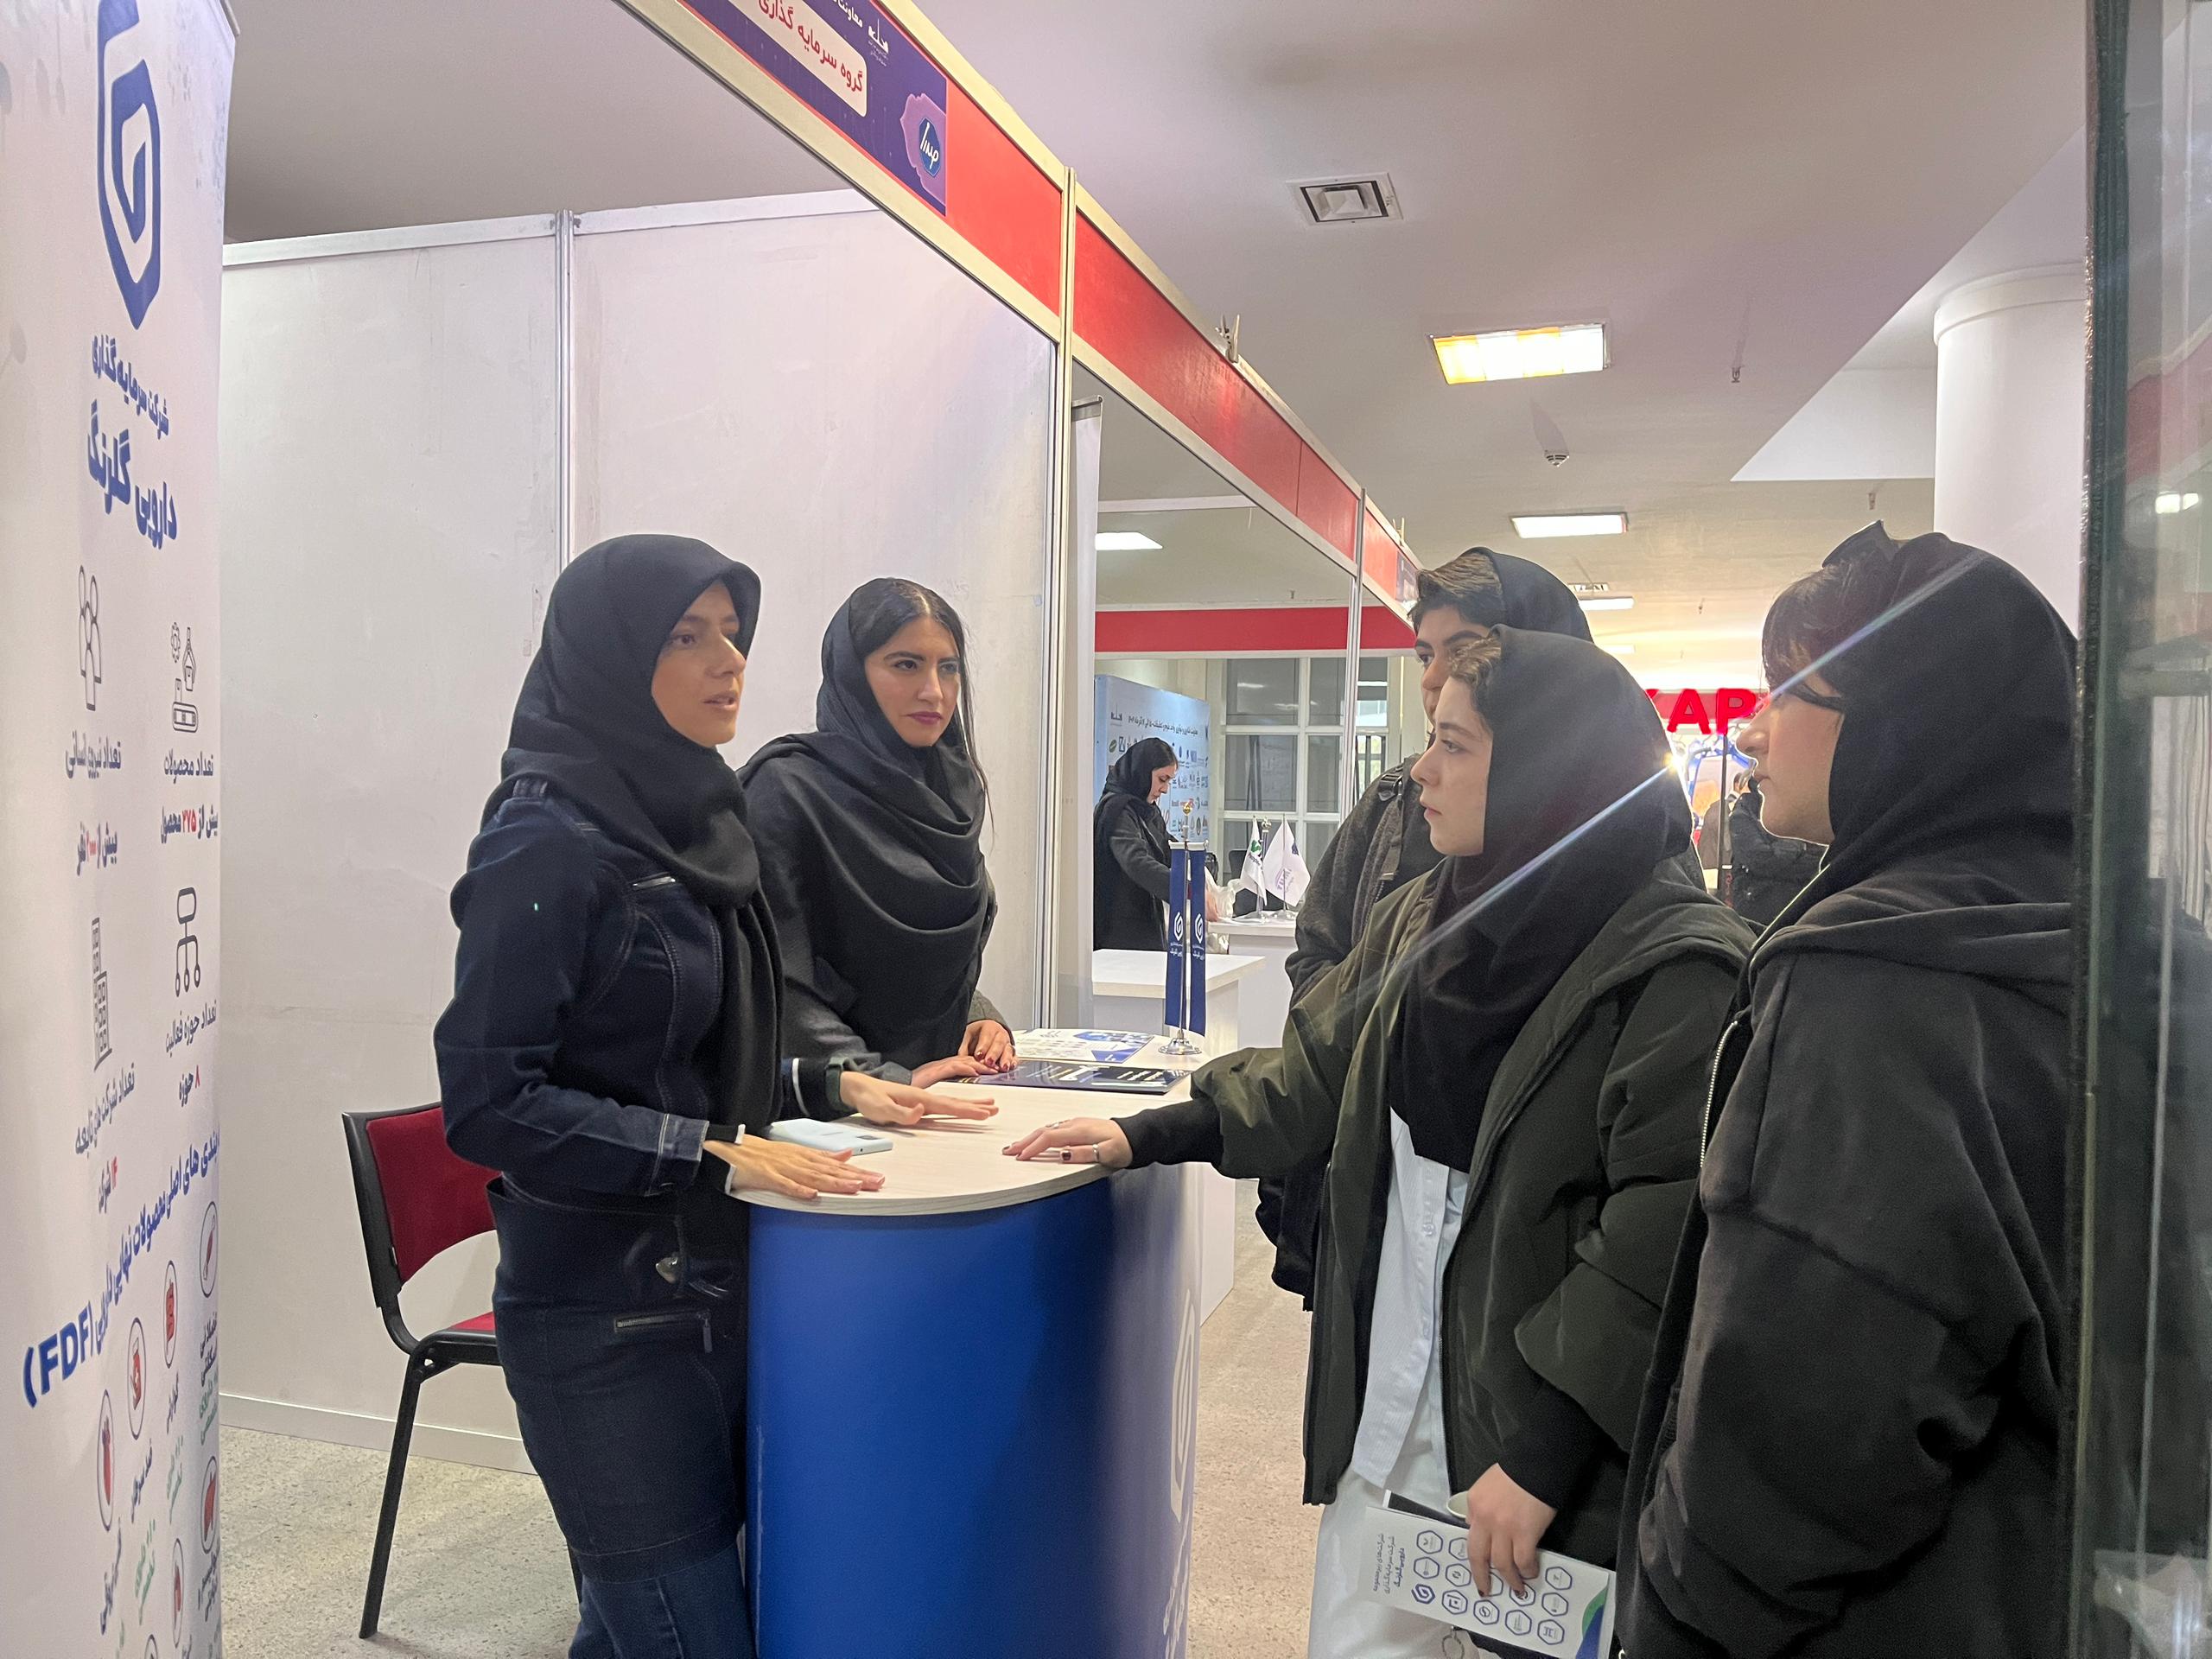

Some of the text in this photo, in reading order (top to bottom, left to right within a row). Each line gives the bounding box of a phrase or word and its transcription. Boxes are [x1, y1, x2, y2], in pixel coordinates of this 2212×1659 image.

[798, 25, 837, 69] سرمایه
[841, 63, 863, 92] گروه
[92, 334, 169, 441] شرکت سرمایه گذاری
[87, 398, 178, 550] دارویی گلرنگ
[1645, 688, 1758, 736] AP
[104, 735, 122, 769] تعداد
[164, 747, 214, 784] تعداد محصولات
[161, 803, 219, 844] بیش از ۲۷۵ محصول
[102, 821, 118, 868] بیش
[185, 1014, 200, 1046] حوزه
[201, 999, 217, 1030] تعداد
[118, 1062, 136, 1103] تعداد
[179, 1064, 201, 1108] ۸ حوزه
